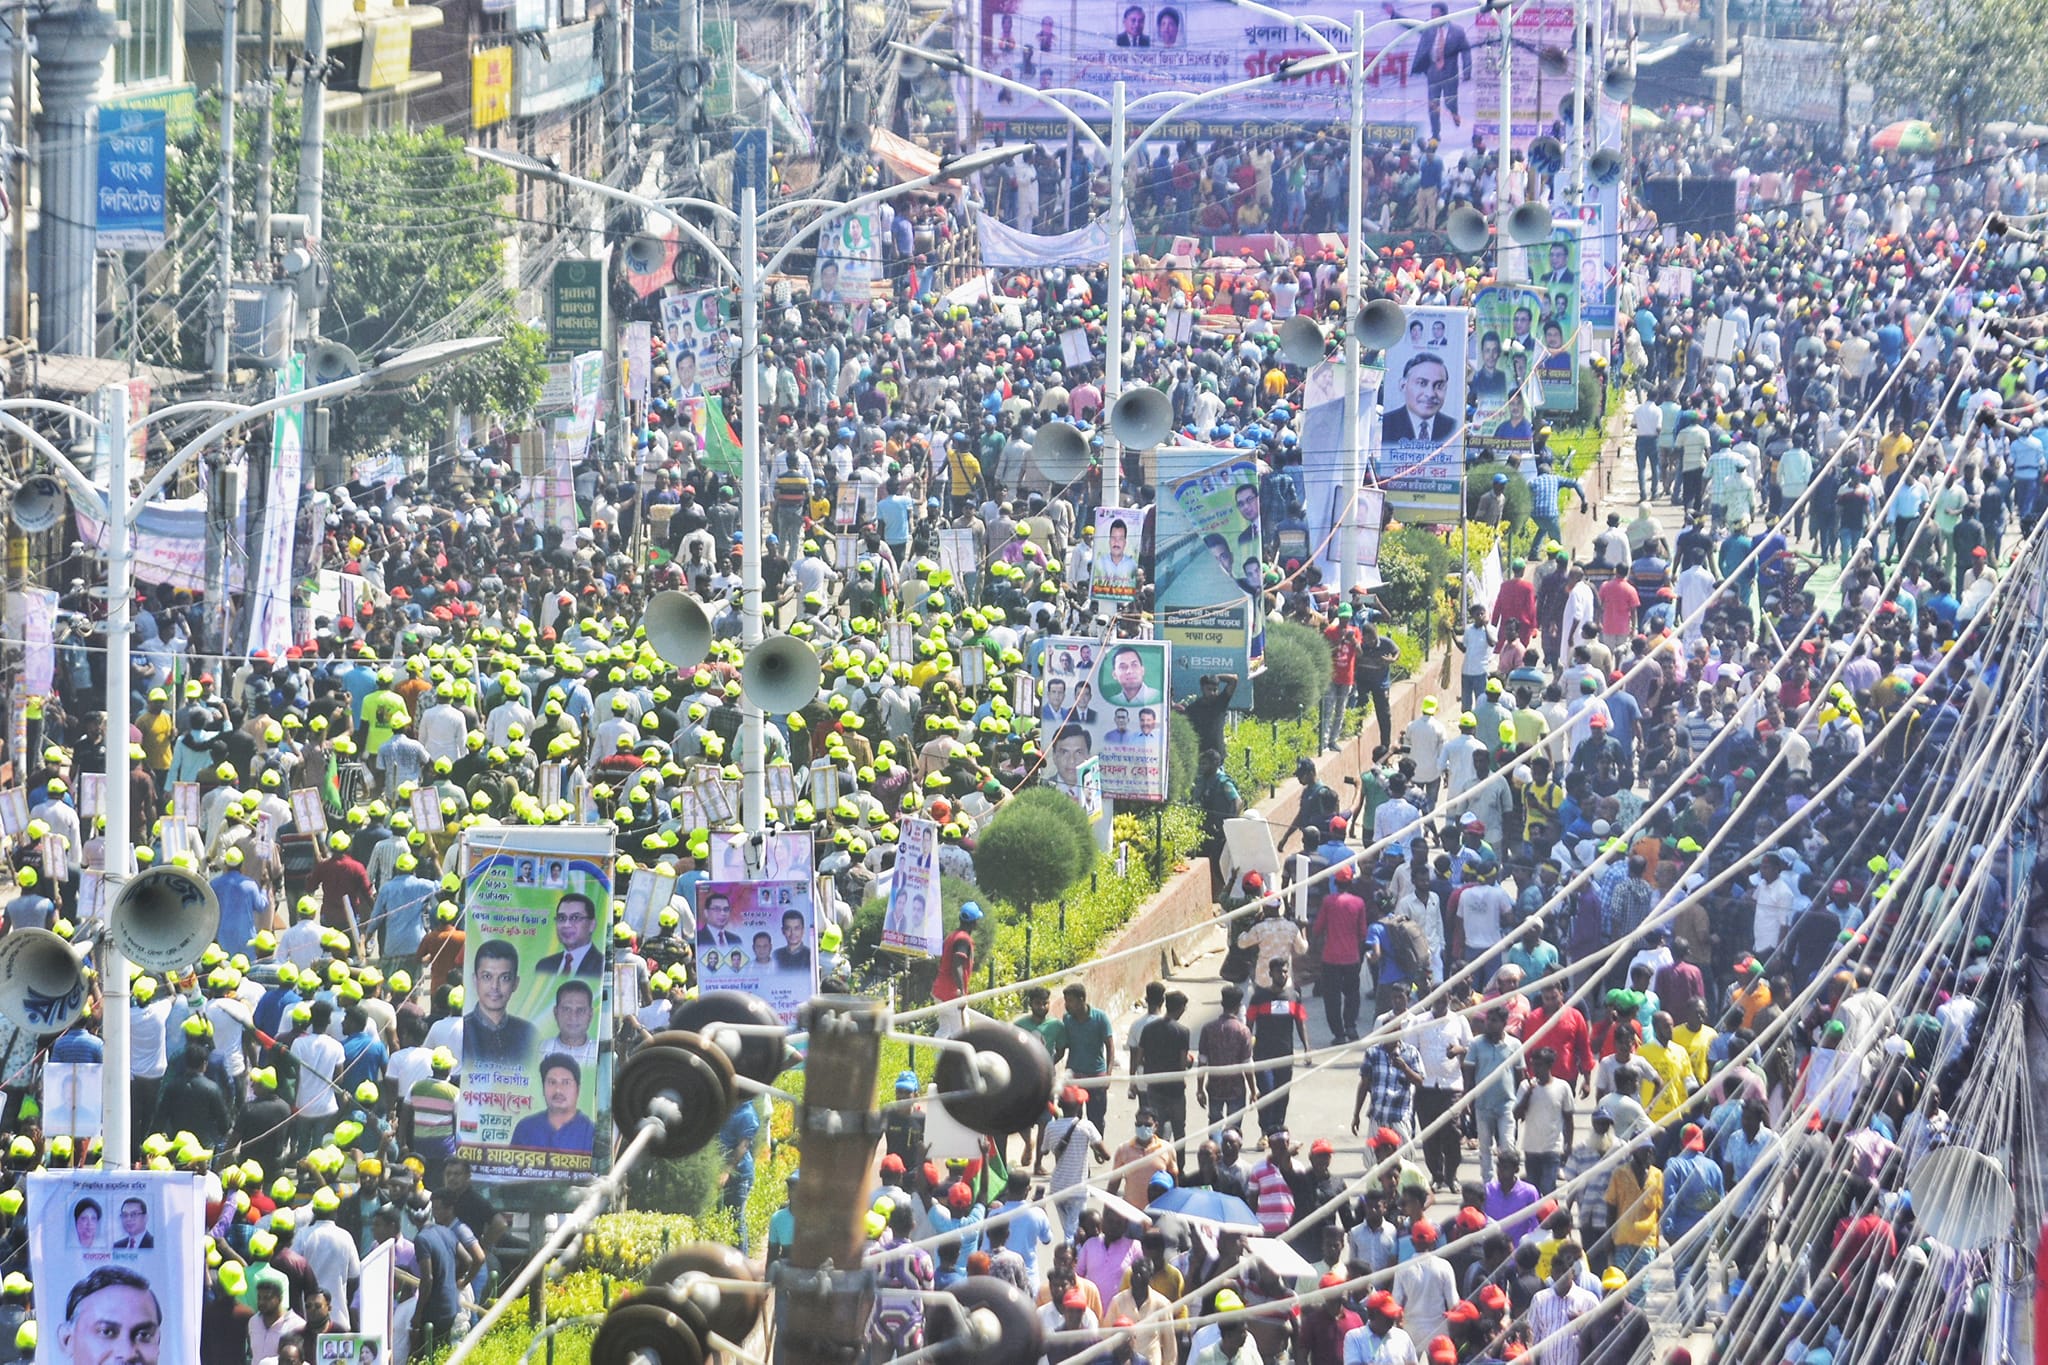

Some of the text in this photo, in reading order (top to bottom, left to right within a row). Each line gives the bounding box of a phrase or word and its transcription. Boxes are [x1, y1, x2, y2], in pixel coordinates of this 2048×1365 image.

[1244, 26, 1288, 44] খুলনা
[1367, 122, 1417, 140] বিভাগ
[109, 136, 155, 156] জনতা
[109, 160, 154, 183] ব্যাংক
[98, 186, 164, 214] লিমিটেড
[556, 315, 599, 330] লিমিটেড
[1184, 632, 1223, 644] পদ্মা সেতু
[1191, 656, 1234, 667] BSRM
[1099, 764, 1158, 777] সফল হোক
[480, 923, 505, 934] নিঃশর্ত
[506, 926, 521, 937] মুক্তি
[468, 1071, 529, 1087] খুলনা বিভাগীয়
[462, 1091, 534, 1115] গণসমাবেশ
[479, 1113, 513, 1127] সফল
[481, 1128, 511, 1142] হোক
[456, 1145, 593, 1170] মোঃ মাহাবুবুর রহমান
[521, 1168, 554, 1179] দৌলতপুর
[82, 1252, 111, 1261] বাংলাদেশ
